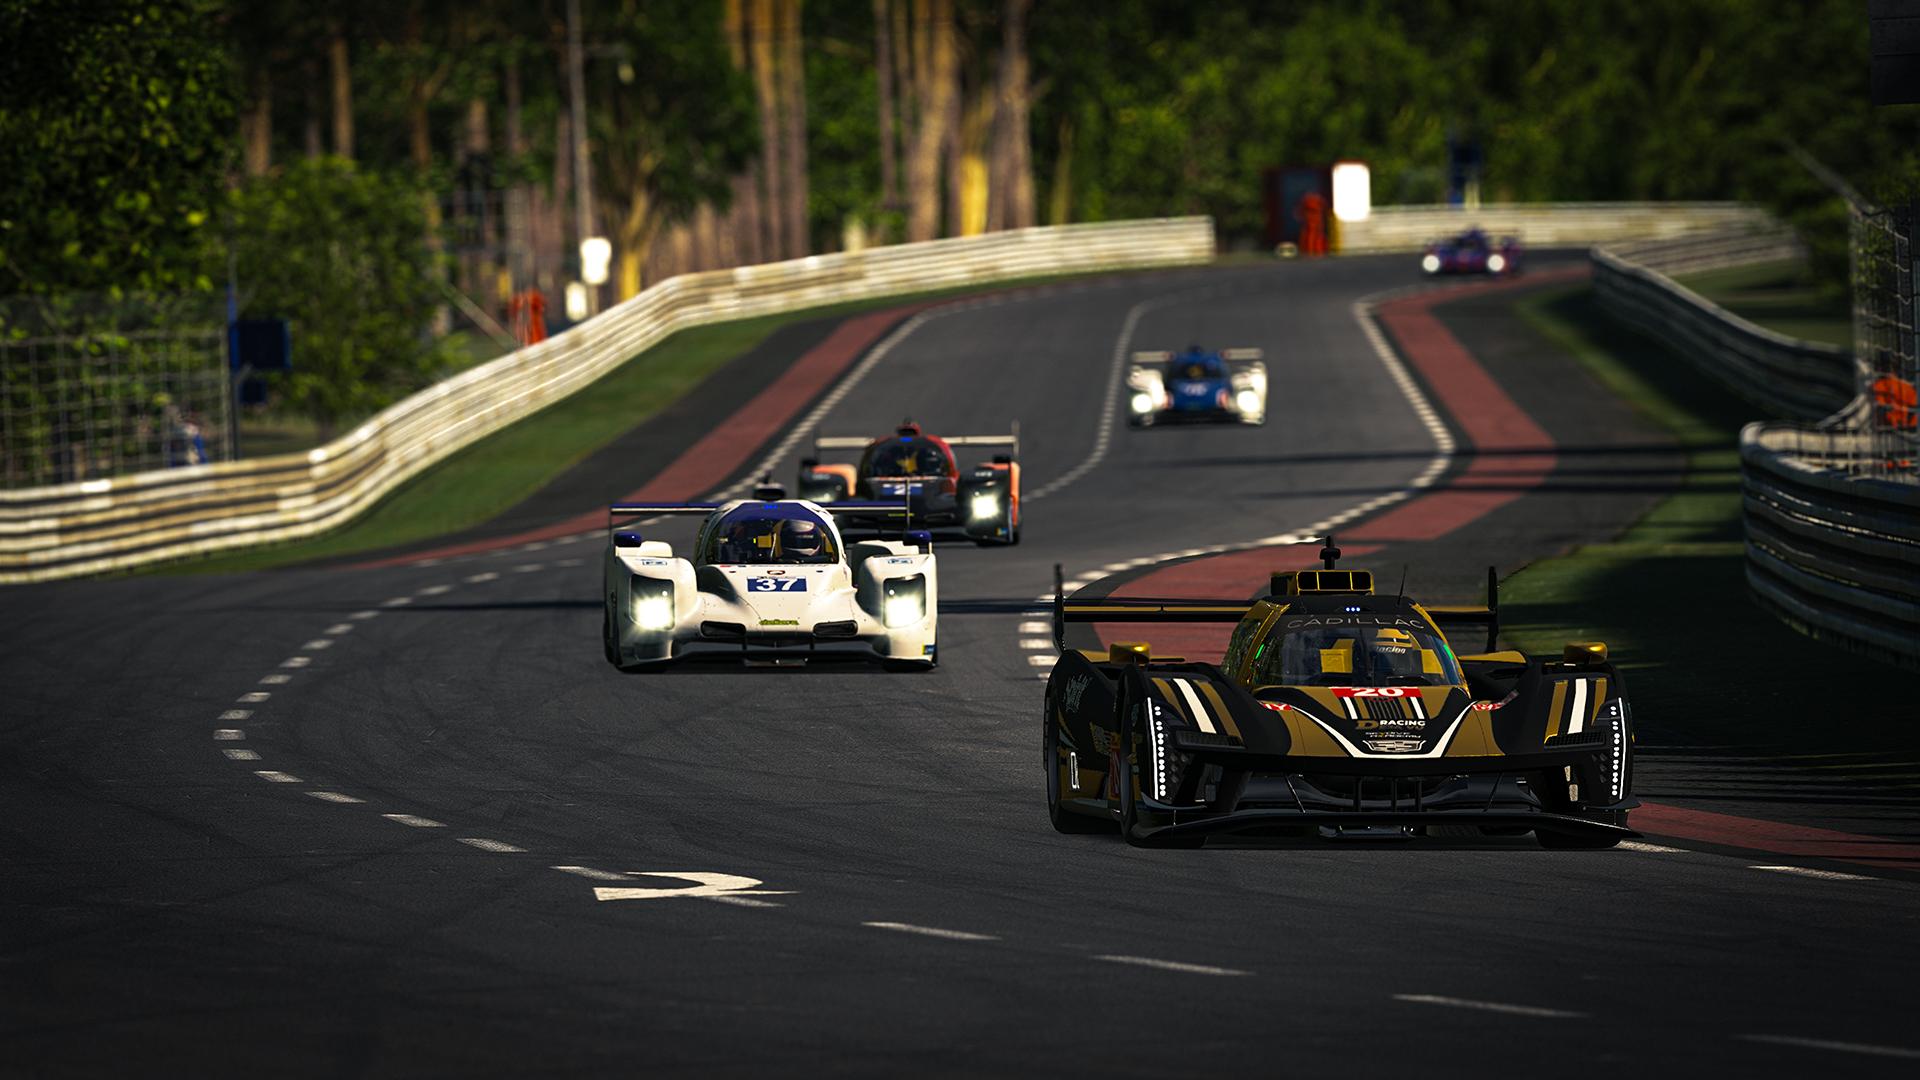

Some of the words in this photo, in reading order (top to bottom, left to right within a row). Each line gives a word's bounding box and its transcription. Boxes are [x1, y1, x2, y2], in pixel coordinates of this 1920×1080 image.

[756, 579, 798, 591] 37
[1287, 615, 1425, 629] CADILLAC
[1351, 687, 1404, 697] 20
